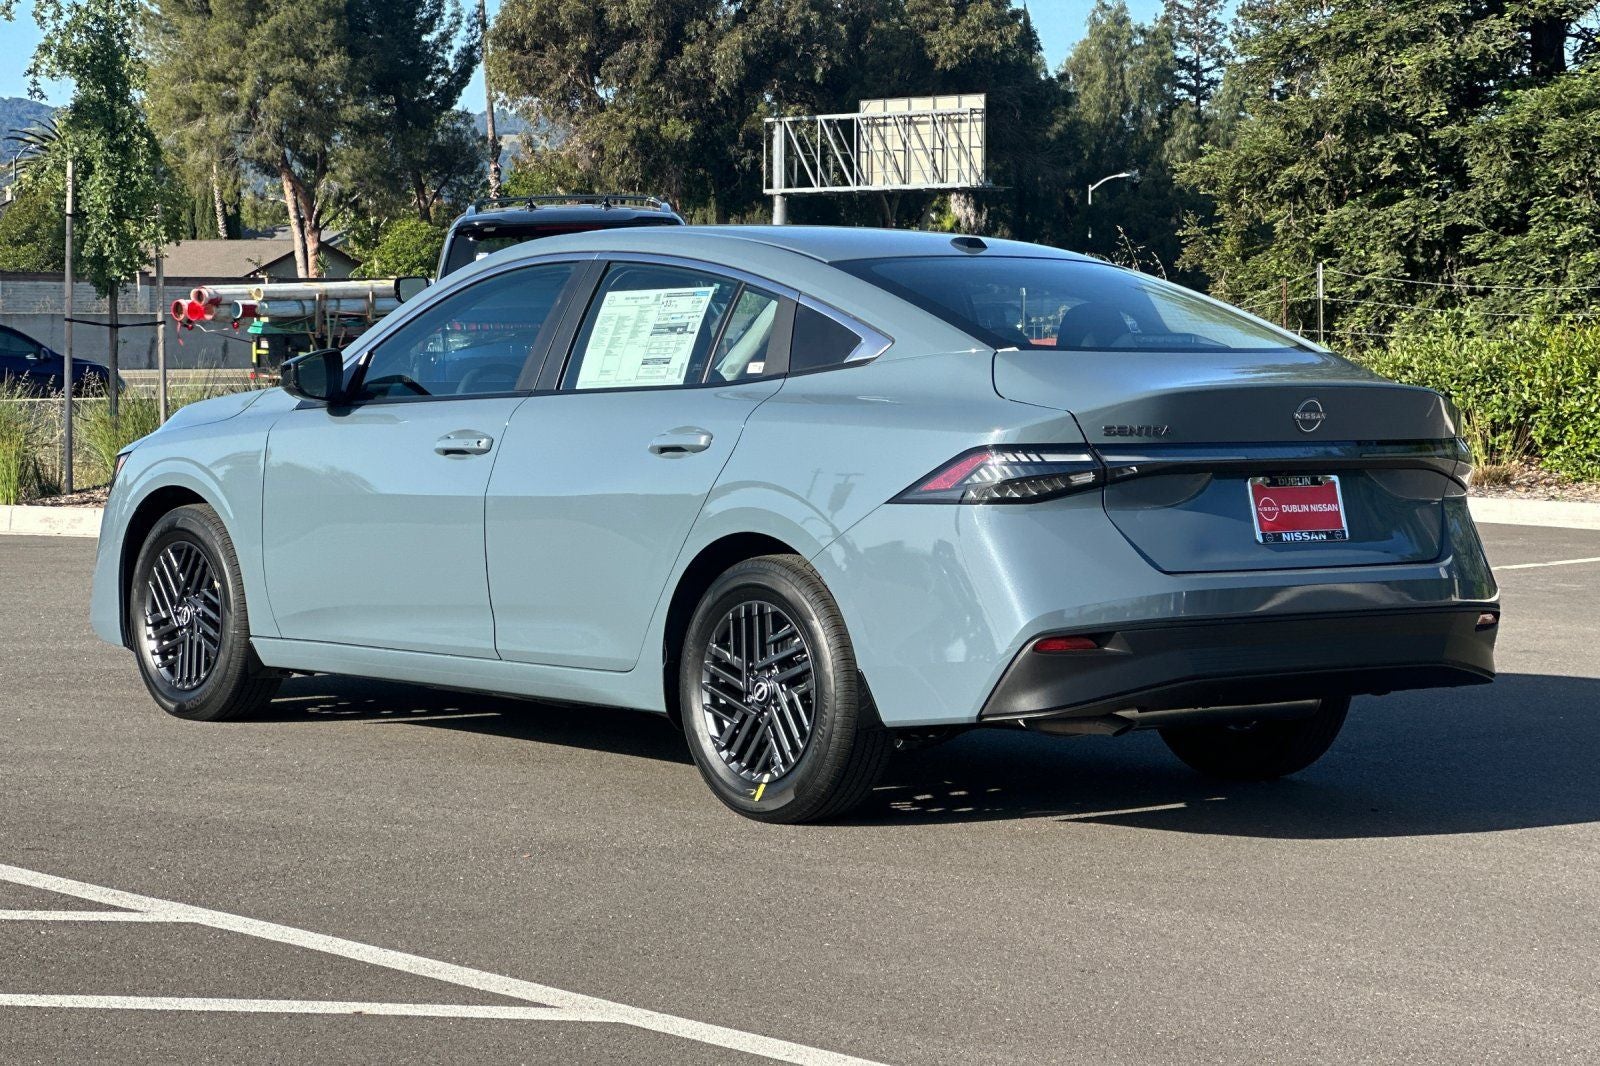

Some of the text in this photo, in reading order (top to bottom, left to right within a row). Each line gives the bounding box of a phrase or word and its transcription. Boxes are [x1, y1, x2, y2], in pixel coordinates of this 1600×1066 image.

[1293, 411, 1327, 420] NISSAN
[1102, 424, 1172, 437] SENTRA
[1278, 476, 1311, 486] DUBLIN
[1281, 503, 1339, 513] DUBLIN NISSAN
[1282, 531, 1328, 542] NISSAN
